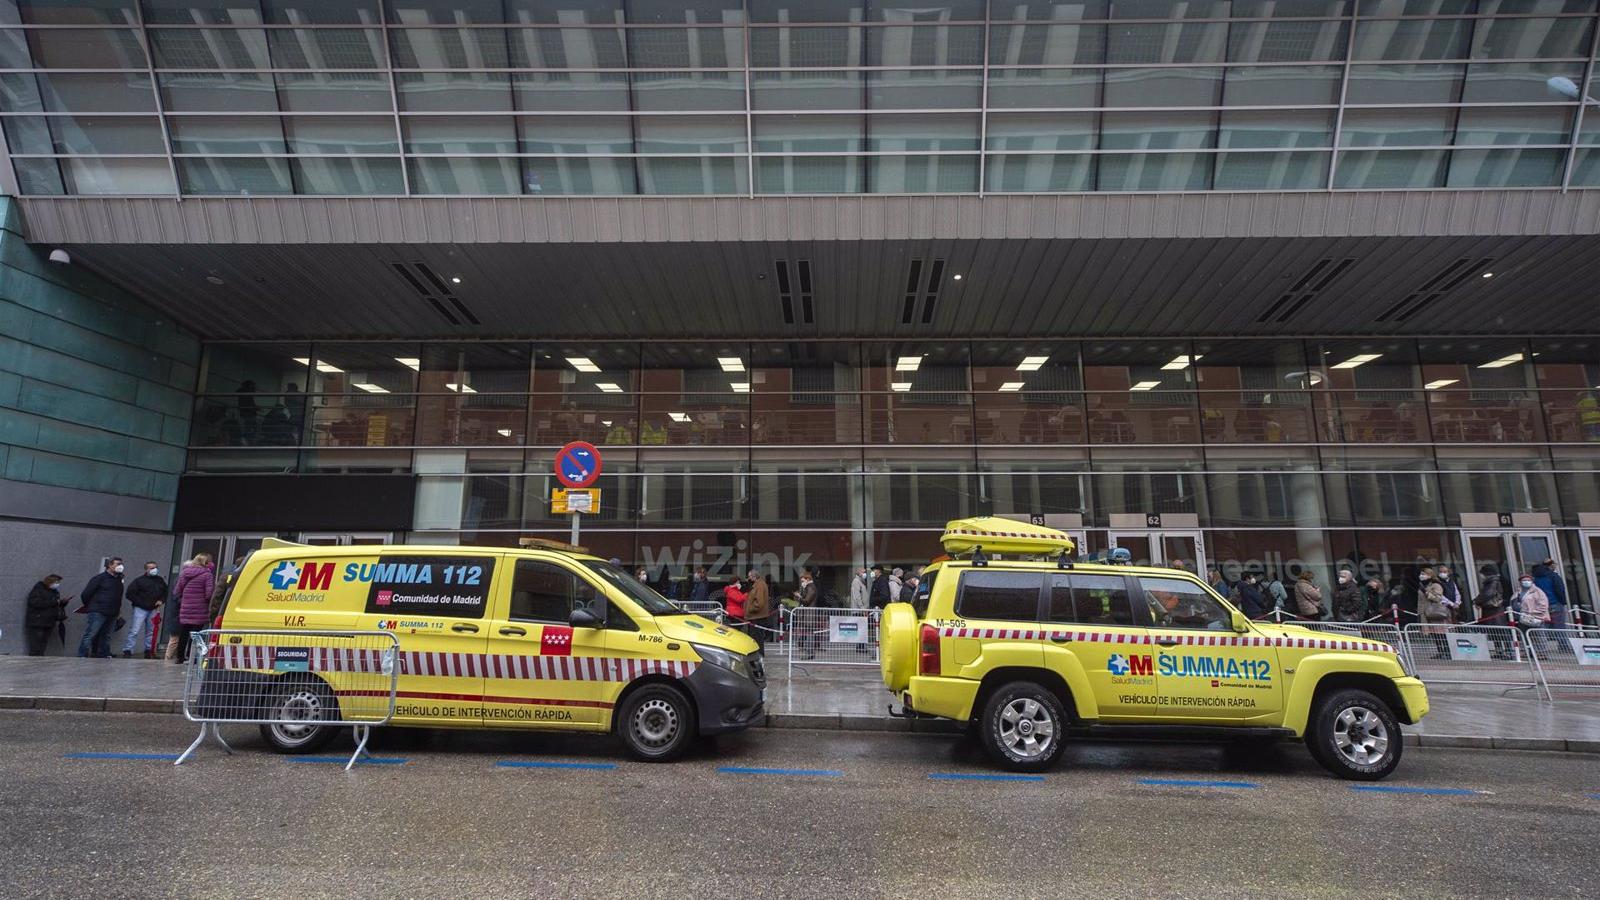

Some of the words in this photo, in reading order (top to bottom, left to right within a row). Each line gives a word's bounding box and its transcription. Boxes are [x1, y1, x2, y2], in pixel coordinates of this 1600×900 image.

[1032, 516, 1044, 525] 63
[1148, 516, 1160, 525] 62
[1501, 515, 1511, 524] 61
[642, 539, 813, 583] WiZink
[297, 562, 336, 590] M
[343, 563, 432, 584] SUMMA
[443, 565, 482, 585] 112
[266, 592, 325, 602] SaludMadrid
[392, 593, 440, 604] Comunidad
[440, 595, 451, 604] de
[452, 595, 481, 605] Madrid
[284, 615, 306, 627] V.I.R.
[400, 620, 428, 628] SUMMA
[936, 618, 967, 628] M-505
[638, 634, 663, 643] M-786
[1111, 677, 1153, 686] SaludMadrid
[1119, 694, 1157, 705] VEHÍCULO
[1158, 696, 1169, 705] DE
[1171, 696, 1226, 707] INTERVENCIÓN
[1227, 696, 1256, 708] RÁPIDA
[442, 707, 456, 717] DE
[458, 706, 532, 719] INTERVENCIÓN
[534, 708, 572, 720] RÁPIDA
